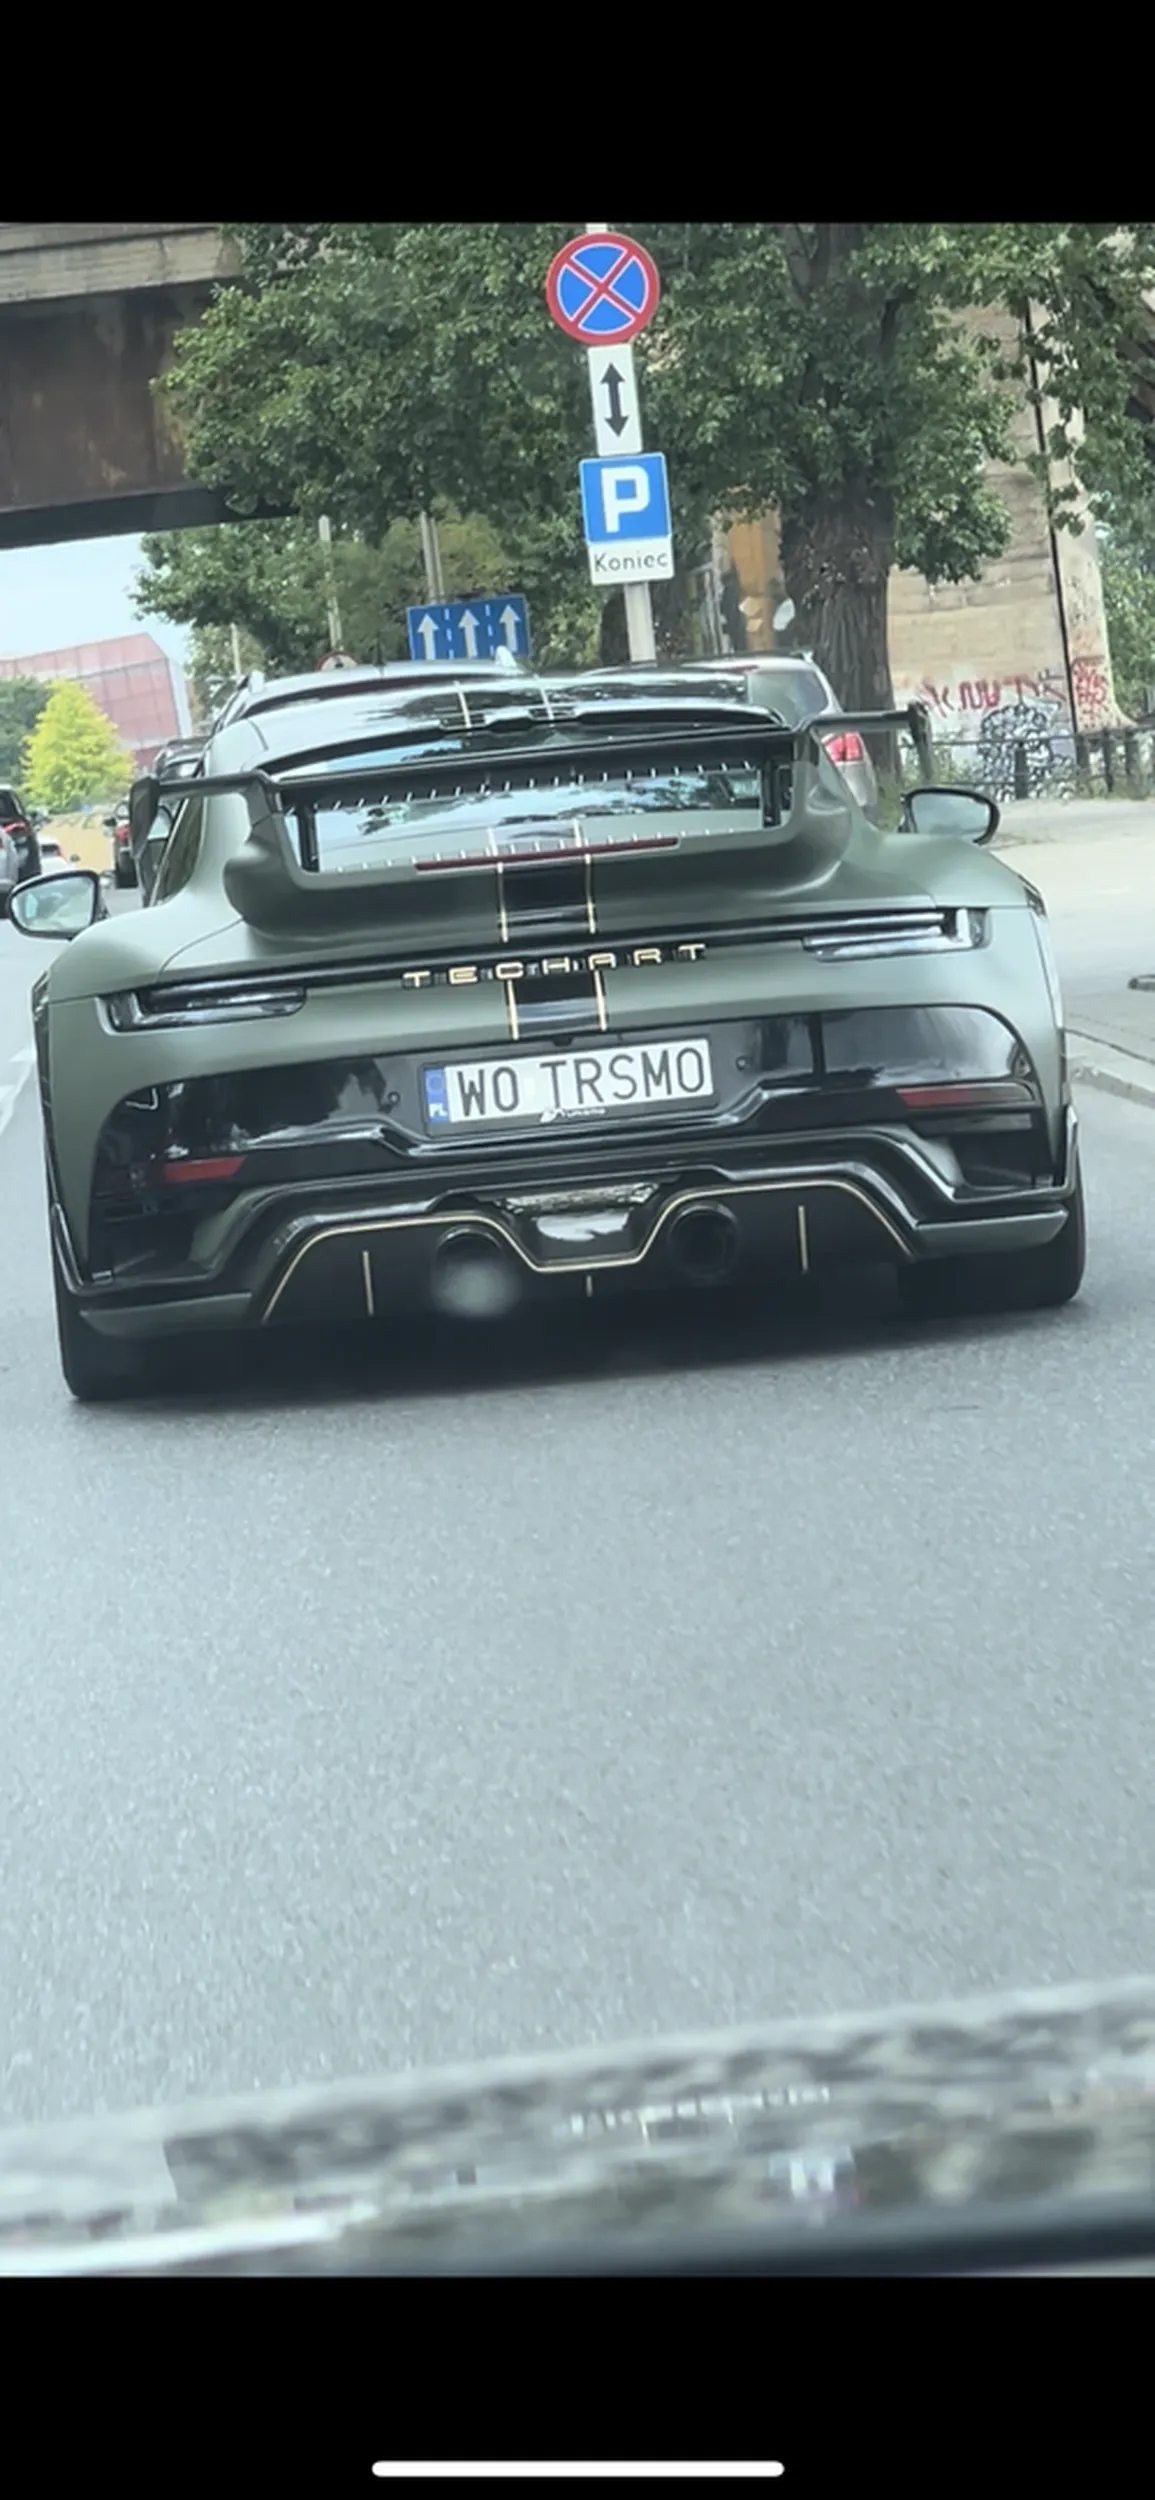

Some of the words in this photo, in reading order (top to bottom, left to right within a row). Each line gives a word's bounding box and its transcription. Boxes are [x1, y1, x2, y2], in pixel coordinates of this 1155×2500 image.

[601, 466, 650, 533] P
[594, 551, 669, 573] Koniec
[402, 943, 706, 988] TECHART
